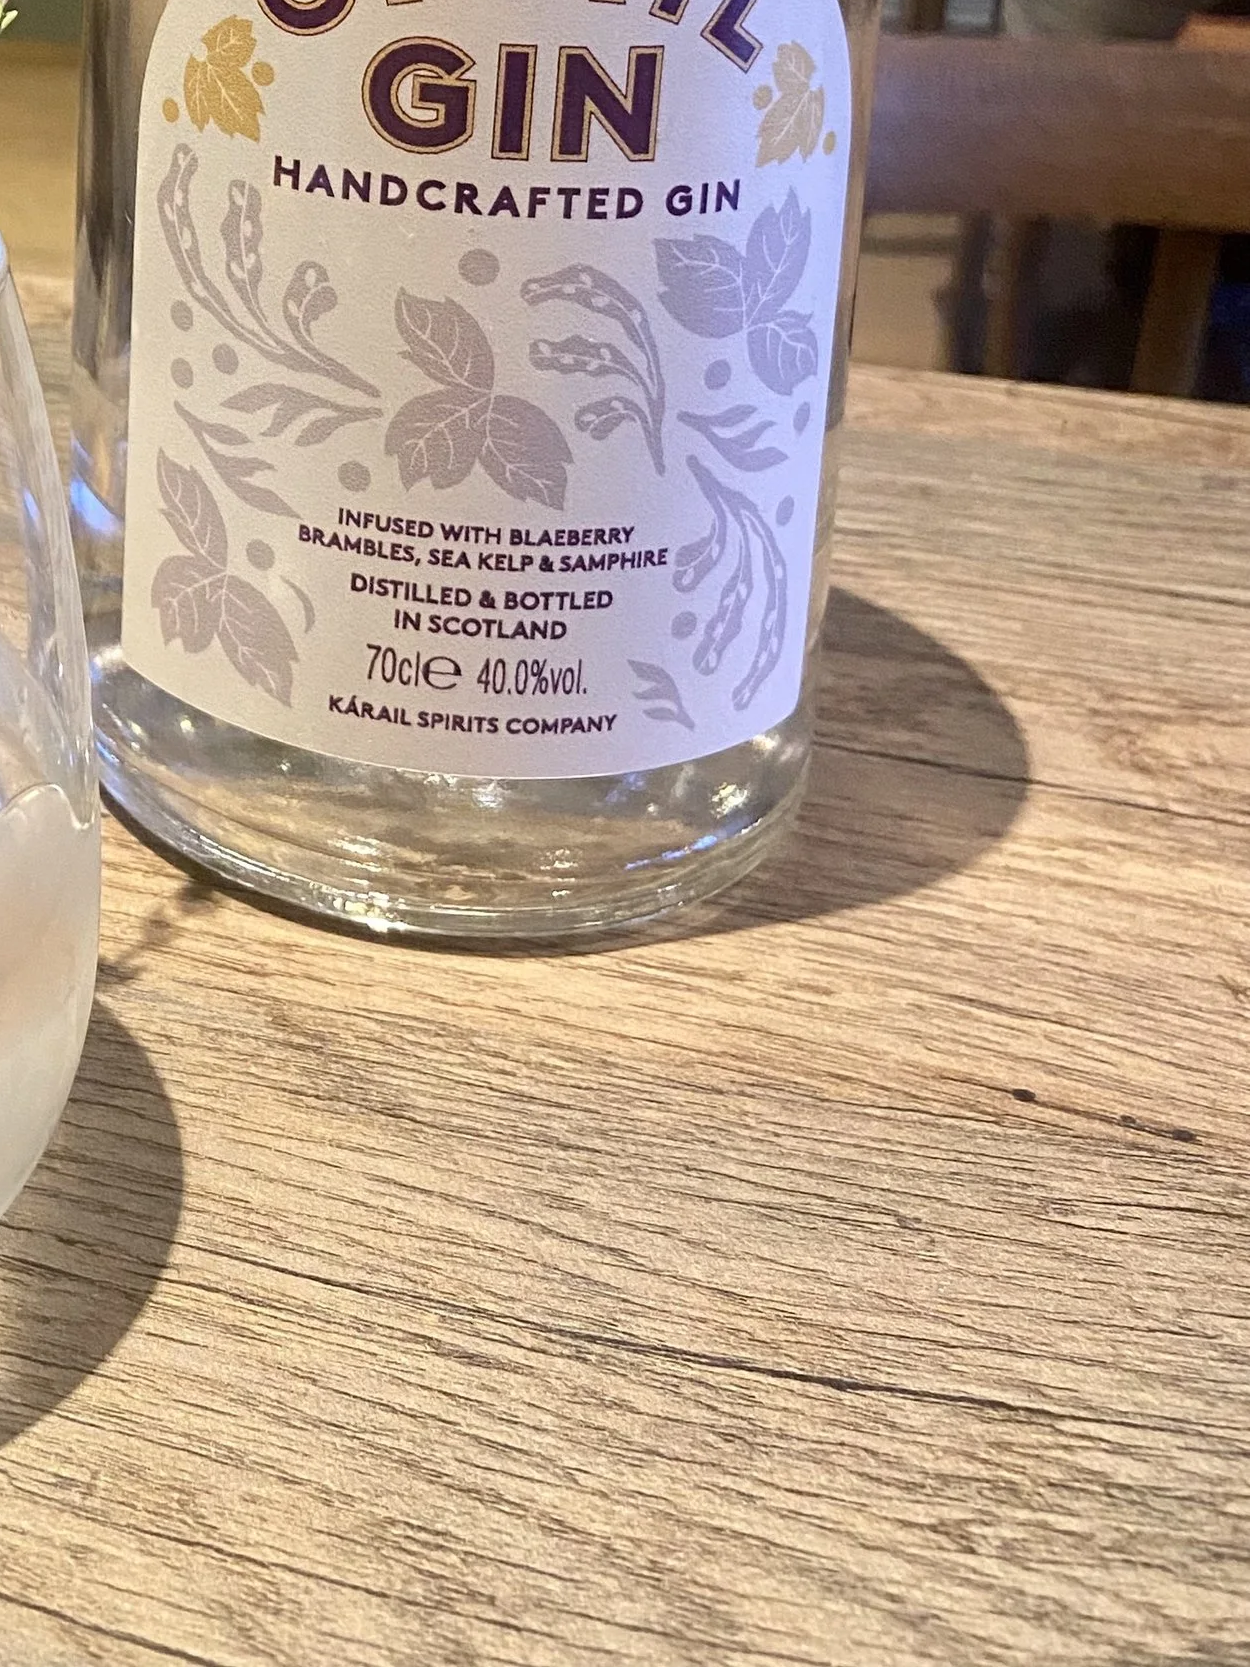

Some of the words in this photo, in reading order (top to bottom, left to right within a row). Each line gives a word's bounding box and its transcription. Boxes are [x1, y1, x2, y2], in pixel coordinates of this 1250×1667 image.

[362, 36, 665, 163] GIN
[272, 154, 645, 220] HANDCRAFTED
[664, 178, 743, 216] GIN
[337, 508, 435, 539] INFUSED
[440, 523, 502, 545] WITH
[509, 525, 636, 547] BLAEBERRY
[297, 524, 421, 567] BRAMBLES,
[427, 549, 472, 569] SEA
[478, 553, 534, 573] KELP
[538, 555, 555, 573] &
[558, 547, 669, 574] SAMPHIRE
[350, 572, 472, 607] DISTILLED
[478, 590, 497, 609] &
[503, 590, 614, 611] BOTTLED
[393, 609, 421, 630] IN
[428, 615, 568, 640] SCOTLAND
[328, 694, 412, 726] KÁRAIL
[417, 711, 499, 734] SPIRITS
[506, 714, 617, 734] COMPANY
